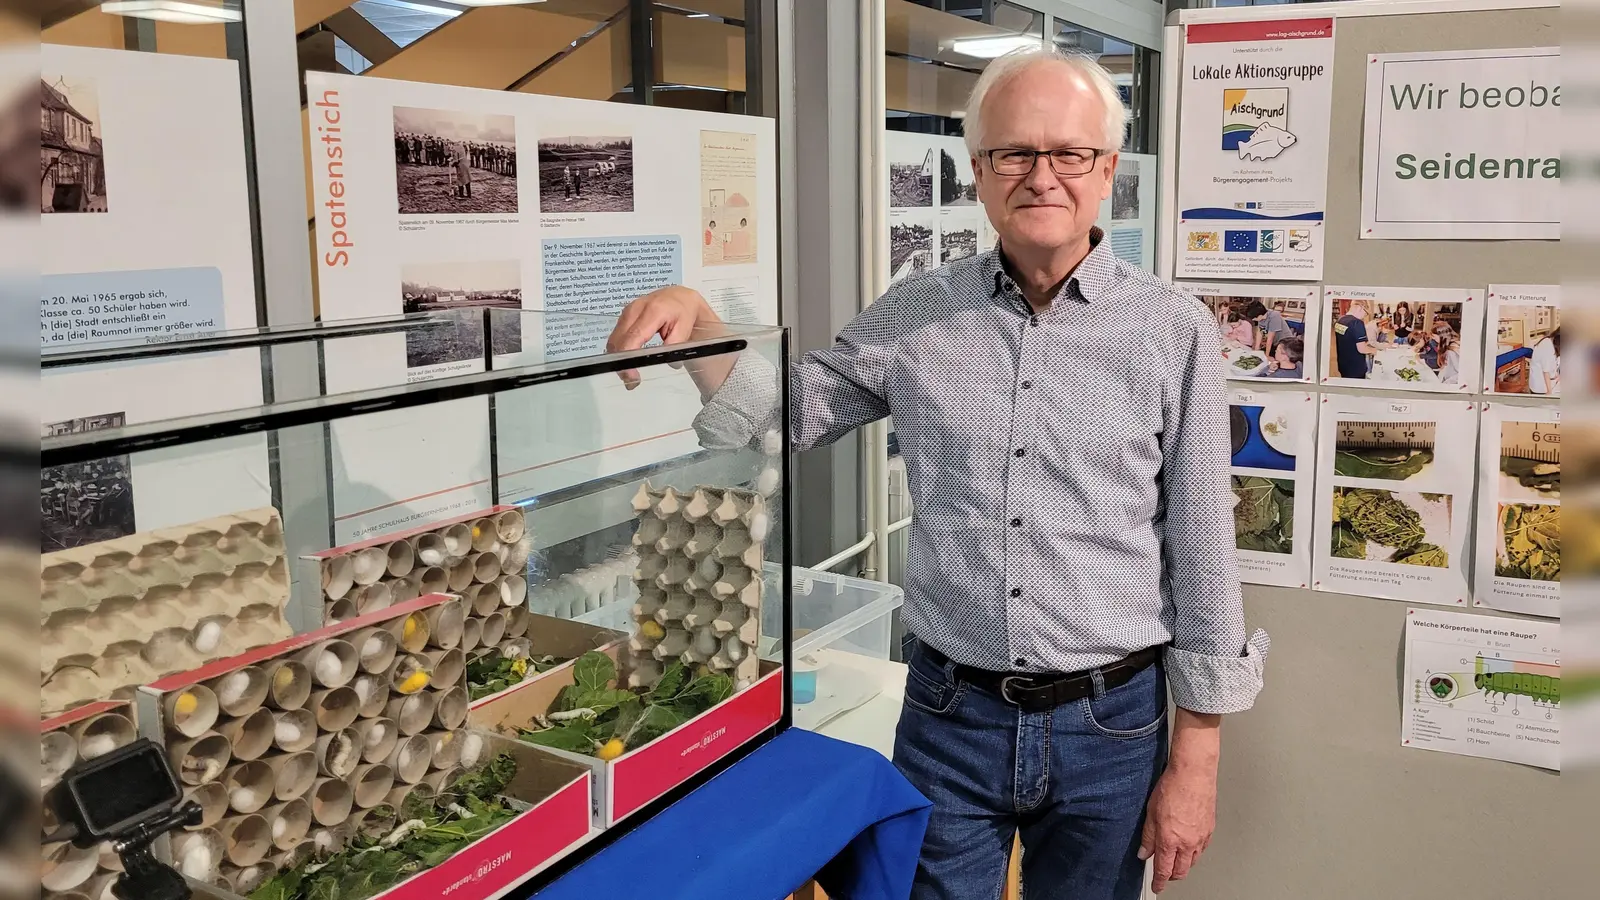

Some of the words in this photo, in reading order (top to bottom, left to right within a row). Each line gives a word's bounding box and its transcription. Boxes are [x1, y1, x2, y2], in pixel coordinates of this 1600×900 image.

[1266, 30, 1325, 38] www.lag-aischgrund.de
[1232, 46, 1258, 54] Unterstützt
[1193, 64, 1231, 80] Lokale
[1235, 64, 1324, 81] Aktionsgruppe
[1390, 82, 1449, 110] Wir
[1230, 102, 1285, 119] Aischgrund
[315, 90, 354, 267] Spatenstich
[1213, 176, 1293, 184] Bürgerengagement-Projekts
[545, 267, 576, 276] Bürgermeister
[574, 281, 609, 289] Hauptteilnehmer
[52, 296, 68, 305] 20.
[72, 295, 89, 304] Mai
[93, 292, 117, 302] 1965
[120, 290, 146, 302] ergab
[148, 289, 168, 299] sich,
[71, 308, 85, 316] ca.
[88, 306, 101, 315] 50
[103, 303, 137, 314] Schüler
[139, 301, 167, 311] haben
[170, 299, 190, 309] wird.
[51, 320, 72, 331] [die]
[75, 318, 99, 328] Stadt
[102, 314, 150, 325] entschließt
[152, 313, 166, 321] ein
[52, 332, 64, 342] da
[68, 330, 88, 342] [die]
[92, 327, 132, 338] Raumnot
[134, 325, 163, 334] immer
[165, 321, 194, 332] größer
[196, 318, 216, 327] wird.
[1391, 404, 1402, 412] Tag
[1342, 430, 1354, 438] 12
[1403, 430, 1416, 439] 14
[1532, 431, 1540, 442] 6
[361, 526, 378, 536] JAHRE
[379, 516, 410, 529] SCHULHAUS
[1341, 567, 1363, 576] Raupen
[1329, 573, 1358, 582] Fütterung
[1506, 582, 1531, 590] Raupen
[1493, 588, 1524, 598] Fütterung
[1413, 620, 1439, 629] Welche
[1440, 623, 1479, 634] Körperteile
[1510, 632, 1537, 640] Raupe?
[703, 726, 726, 747] MAESTRO
[1476, 728, 1511, 738] Bauchbeine
[478, 850, 512, 878] MAESTRO
